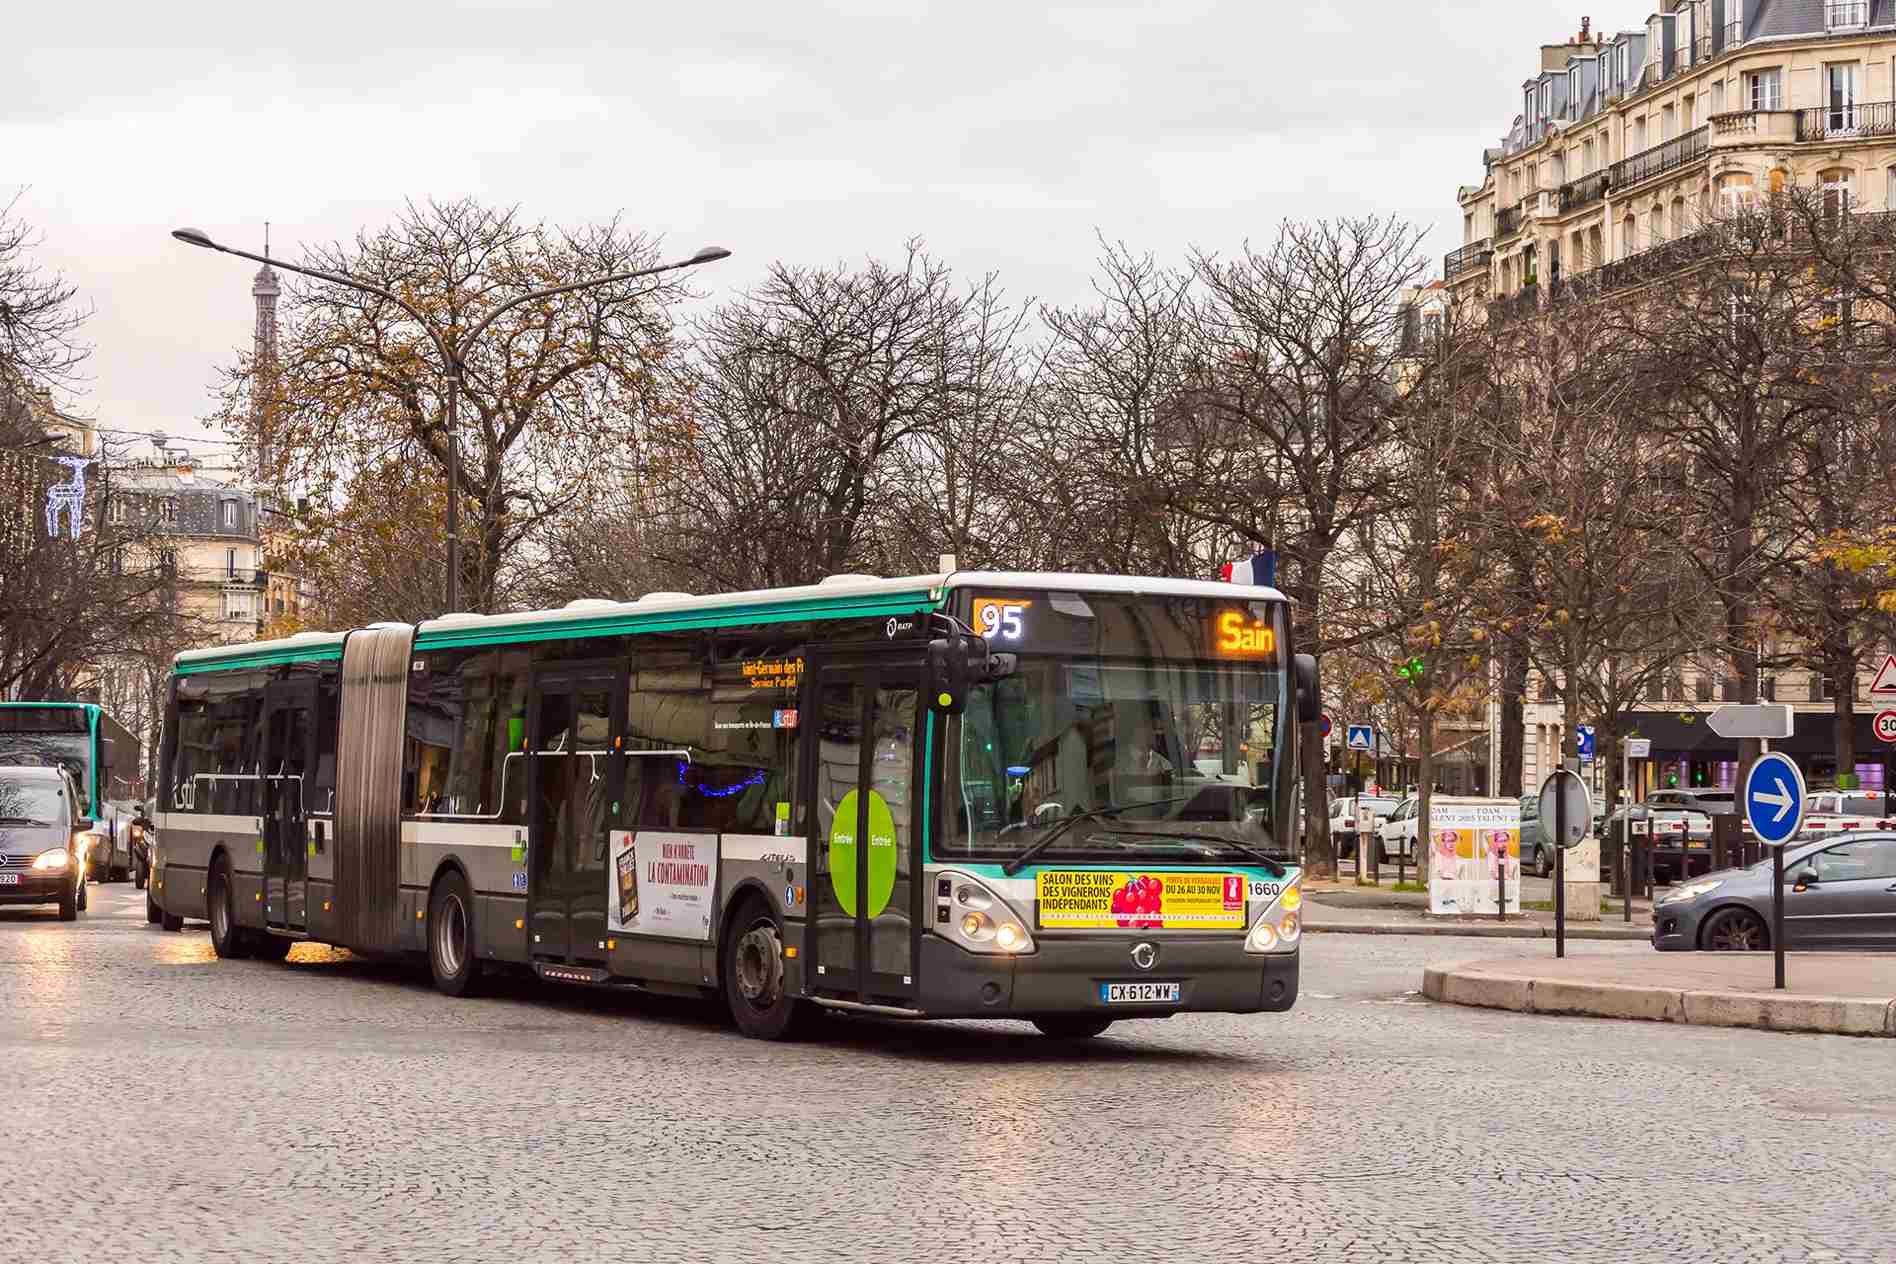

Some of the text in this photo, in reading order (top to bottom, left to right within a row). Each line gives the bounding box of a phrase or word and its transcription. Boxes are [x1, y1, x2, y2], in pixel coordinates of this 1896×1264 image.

[981, 604, 1023, 639] 95
[1220, 611, 1273, 652] Sain
[1881, 719, 1896, 731] 30
[833, 831, 853, 845] Entrée
[871, 834, 892, 847] Entrée
[647, 861, 709, 888] LA CONTAMINATION
[1043, 873, 1114, 886] SALON DES VINS
[1043, 886, 1111, 898] DES VIGNERONS
[1166, 884, 1176, 894] DU
[1177, 884, 1186, 894] 26
[1187, 885, 1197, 894] AU
[1248, 882, 1280, 896] 1660
